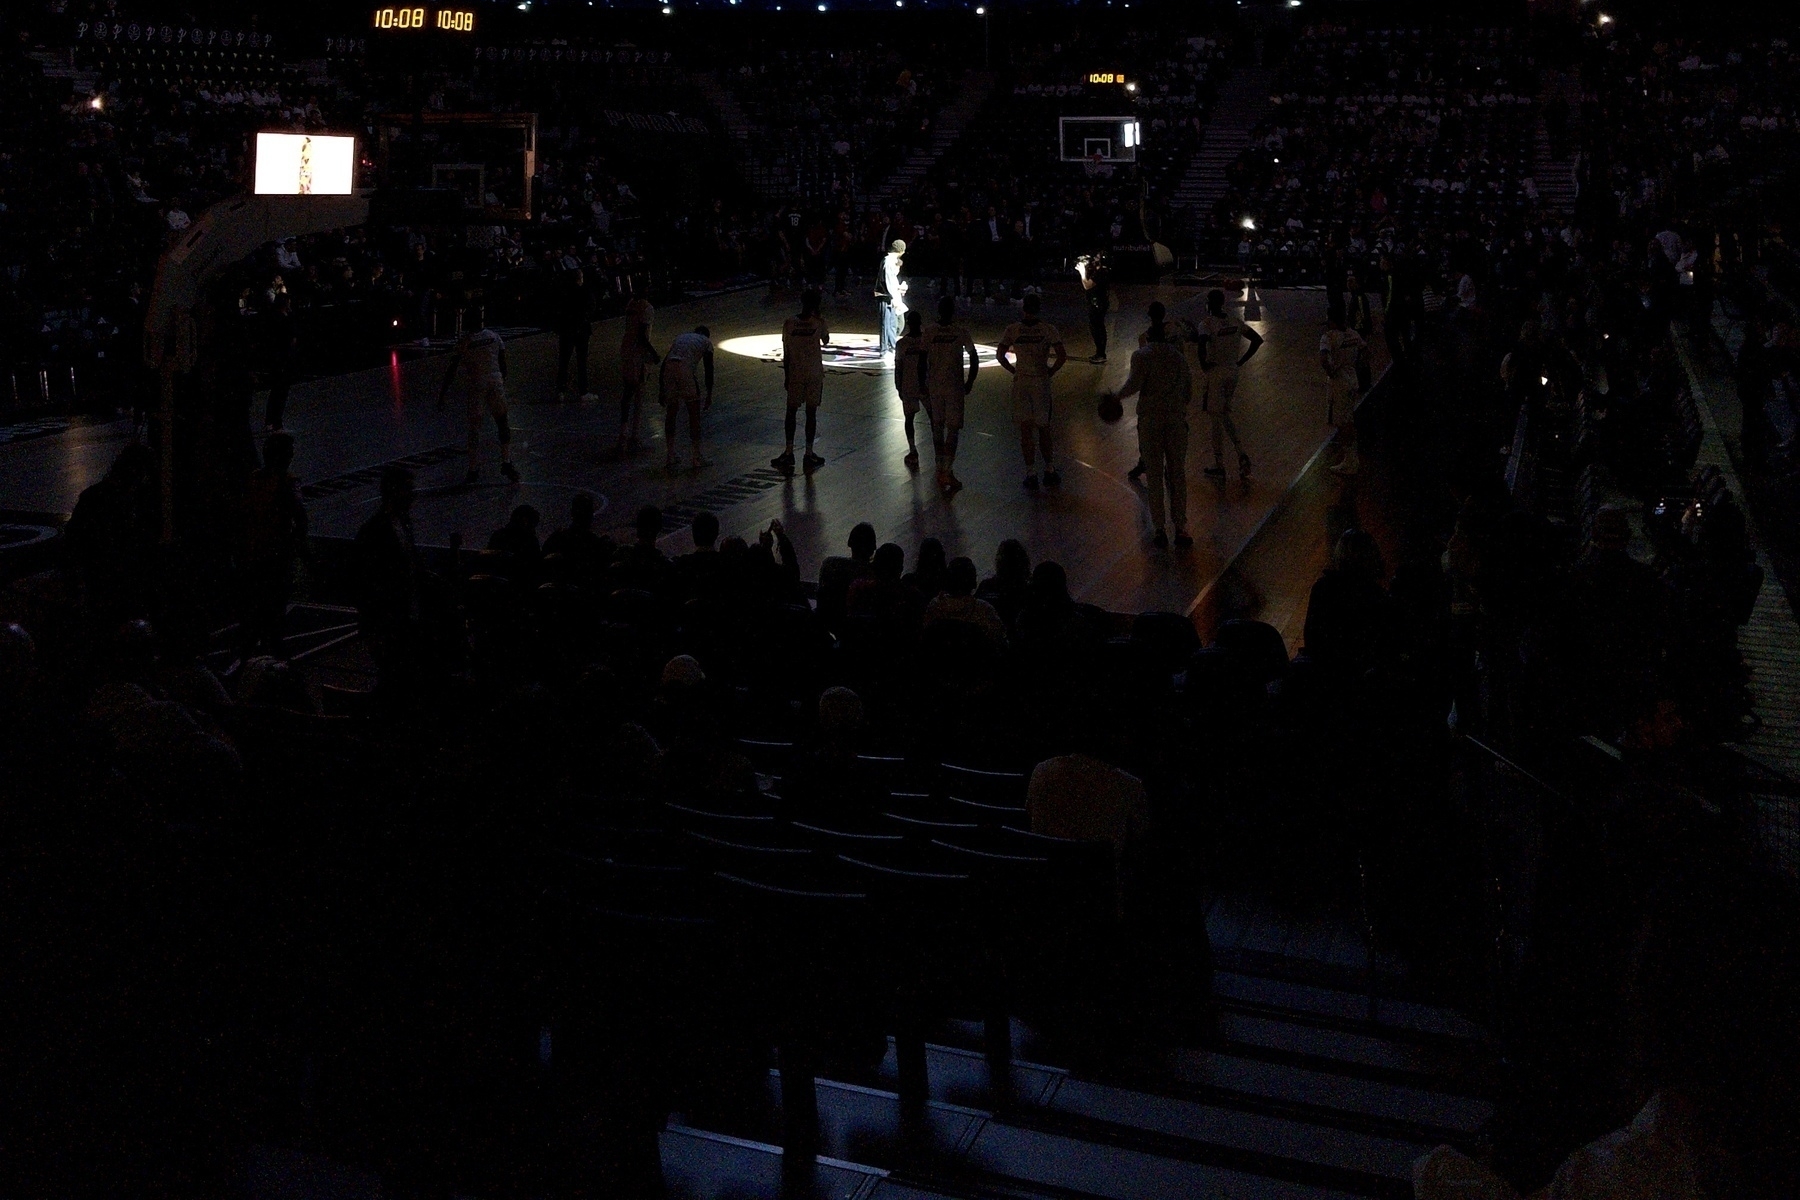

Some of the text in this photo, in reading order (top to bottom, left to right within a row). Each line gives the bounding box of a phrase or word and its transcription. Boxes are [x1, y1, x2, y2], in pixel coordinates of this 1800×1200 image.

[375, 8, 473, 31] 10:08 10:08
[1089, 73, 1114, 83] 10:08
